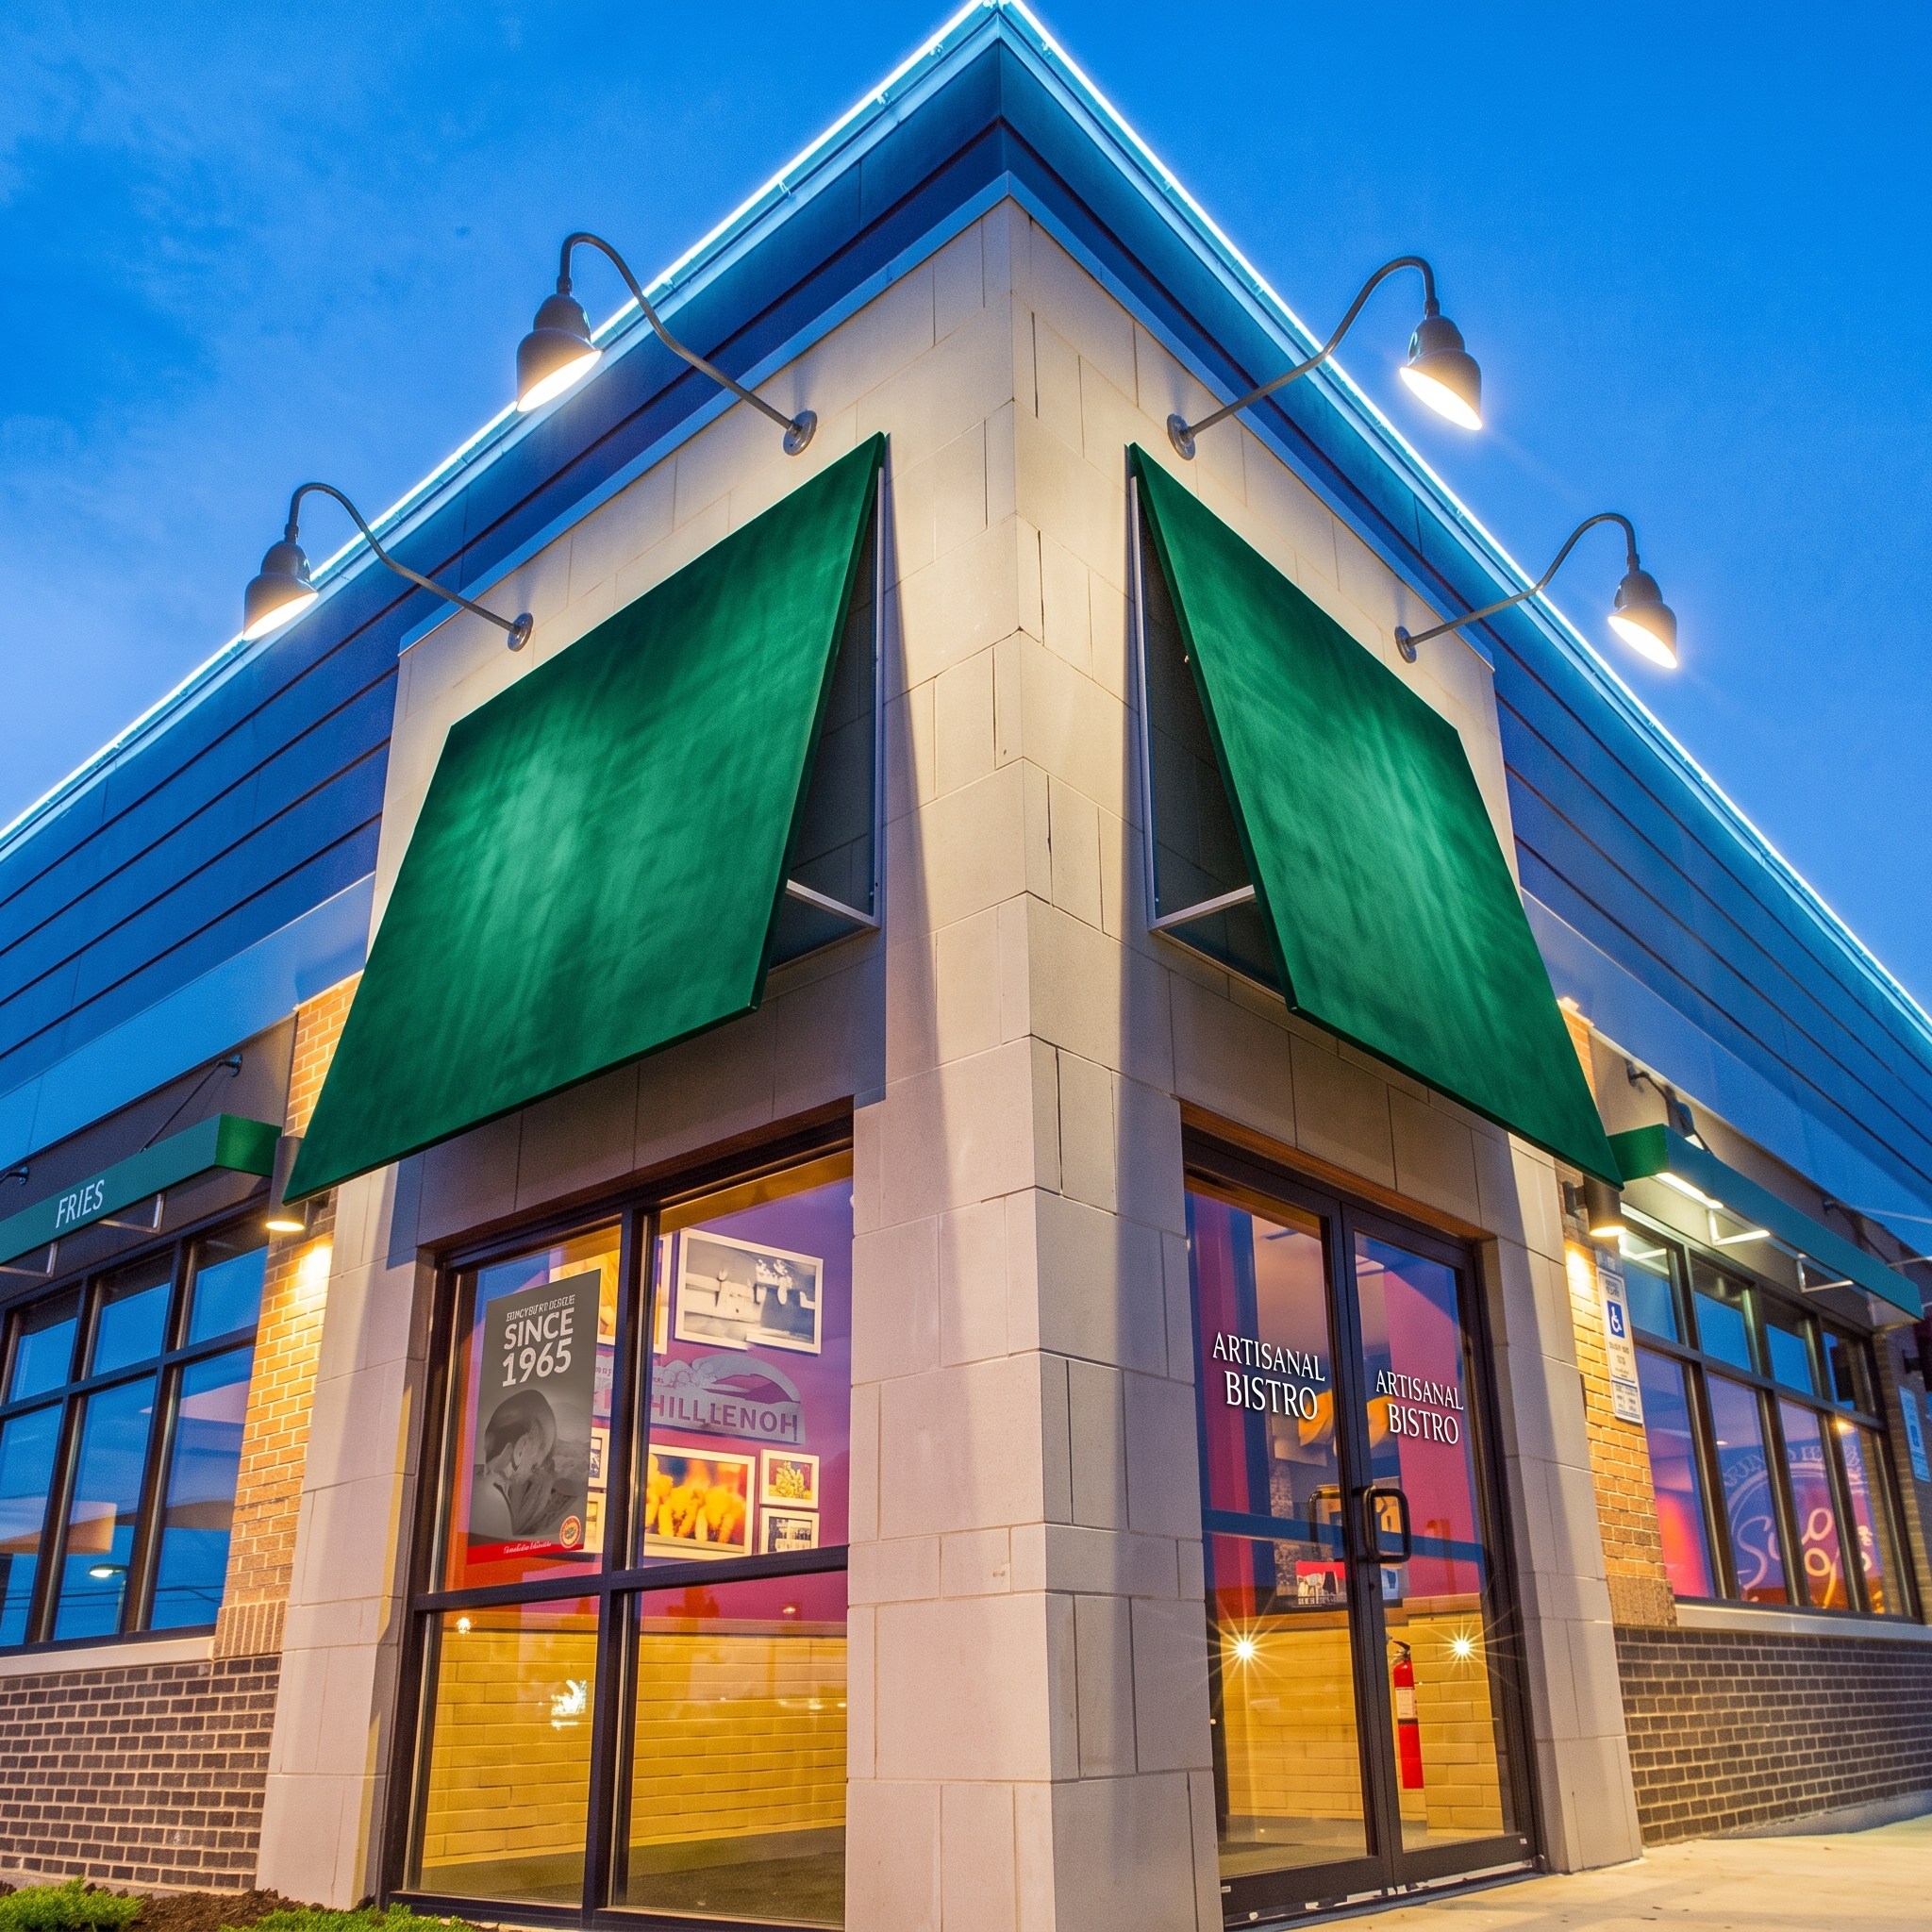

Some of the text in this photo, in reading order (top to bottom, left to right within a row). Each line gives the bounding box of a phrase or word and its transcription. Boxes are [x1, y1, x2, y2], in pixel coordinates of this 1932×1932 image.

[56, 1179, 105, 1229] FRIES
[503, 1307, 575, 1350] SINCE
[502, 1337, 573, 1388] 1965
[1212, 1331, 1325, 1382] ARTISANAL
[1224, 1370, 1318, 1421] BISTRO
[1375, 1369, 1464, 1410] ARTISANAL
[1387, 1403, 1459, 1444] BISTRO
